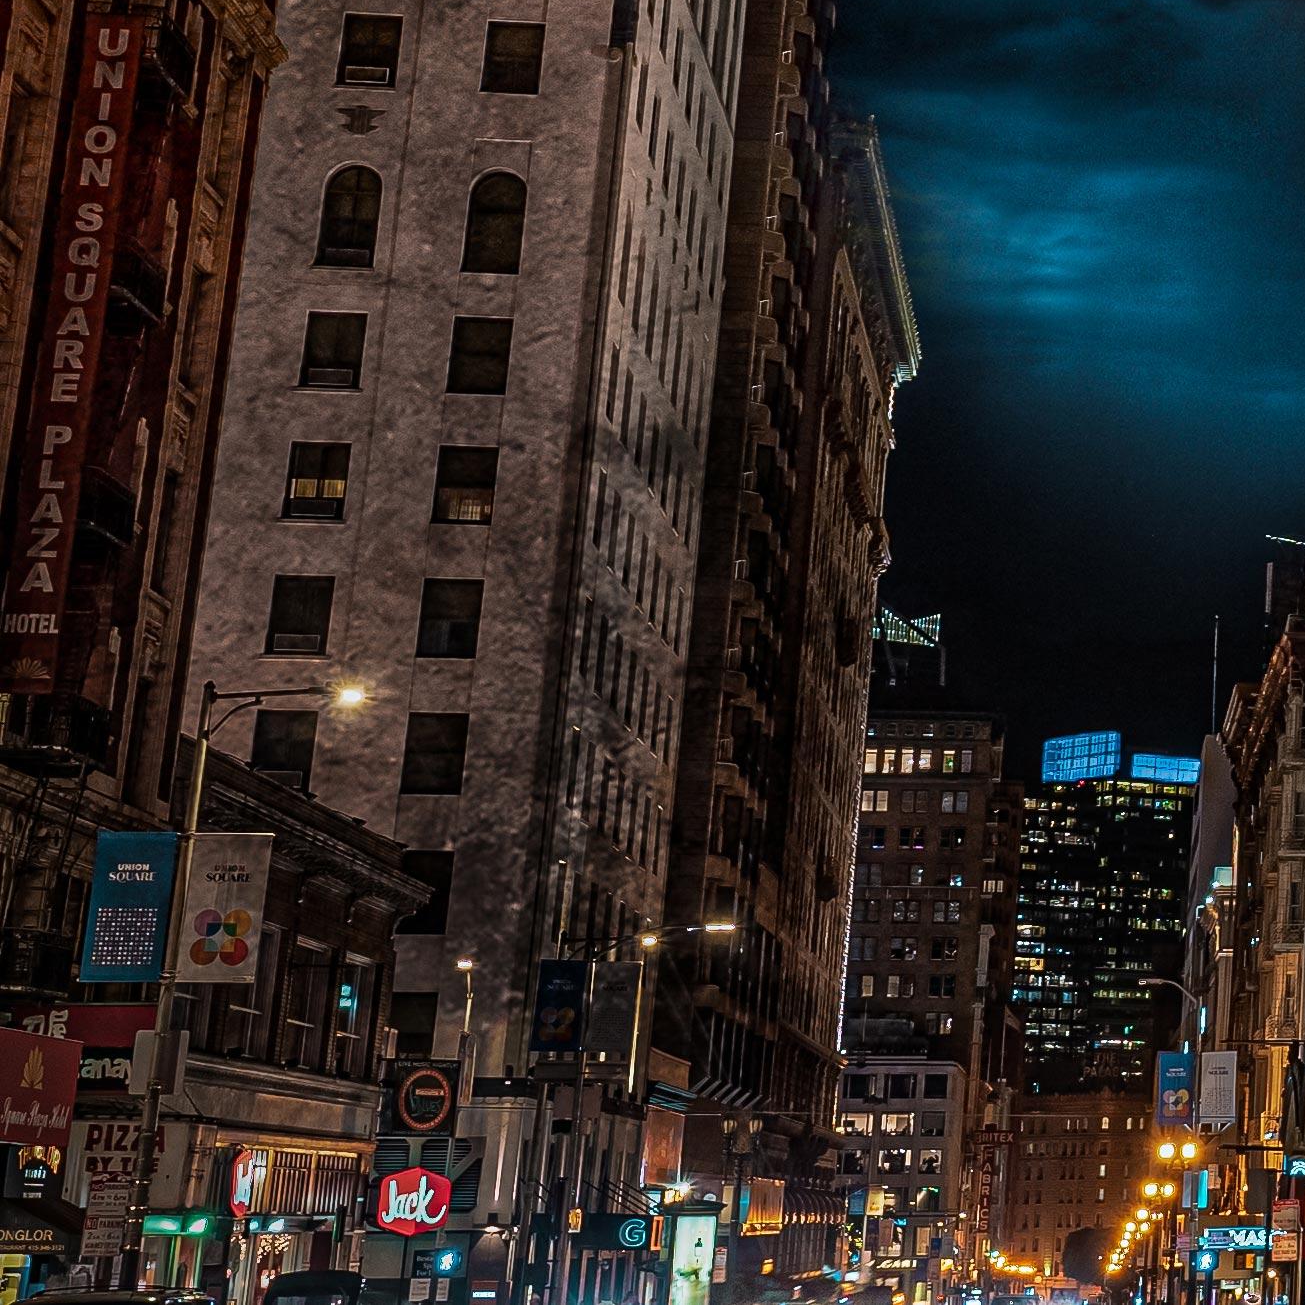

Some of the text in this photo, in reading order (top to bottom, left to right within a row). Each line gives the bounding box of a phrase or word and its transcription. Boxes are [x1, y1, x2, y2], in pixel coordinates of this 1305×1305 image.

[19, 27, 130, 594] UNION SQUARE PLAZA
[3, 613, 60, 636] HOTEL
[108, 871, 157, 883] SQUARE
[117, 863, 150, 871] UNION
[382, 1175, 447, 1225] Jack
[980, 1148, 994, 1229] FABRICS
